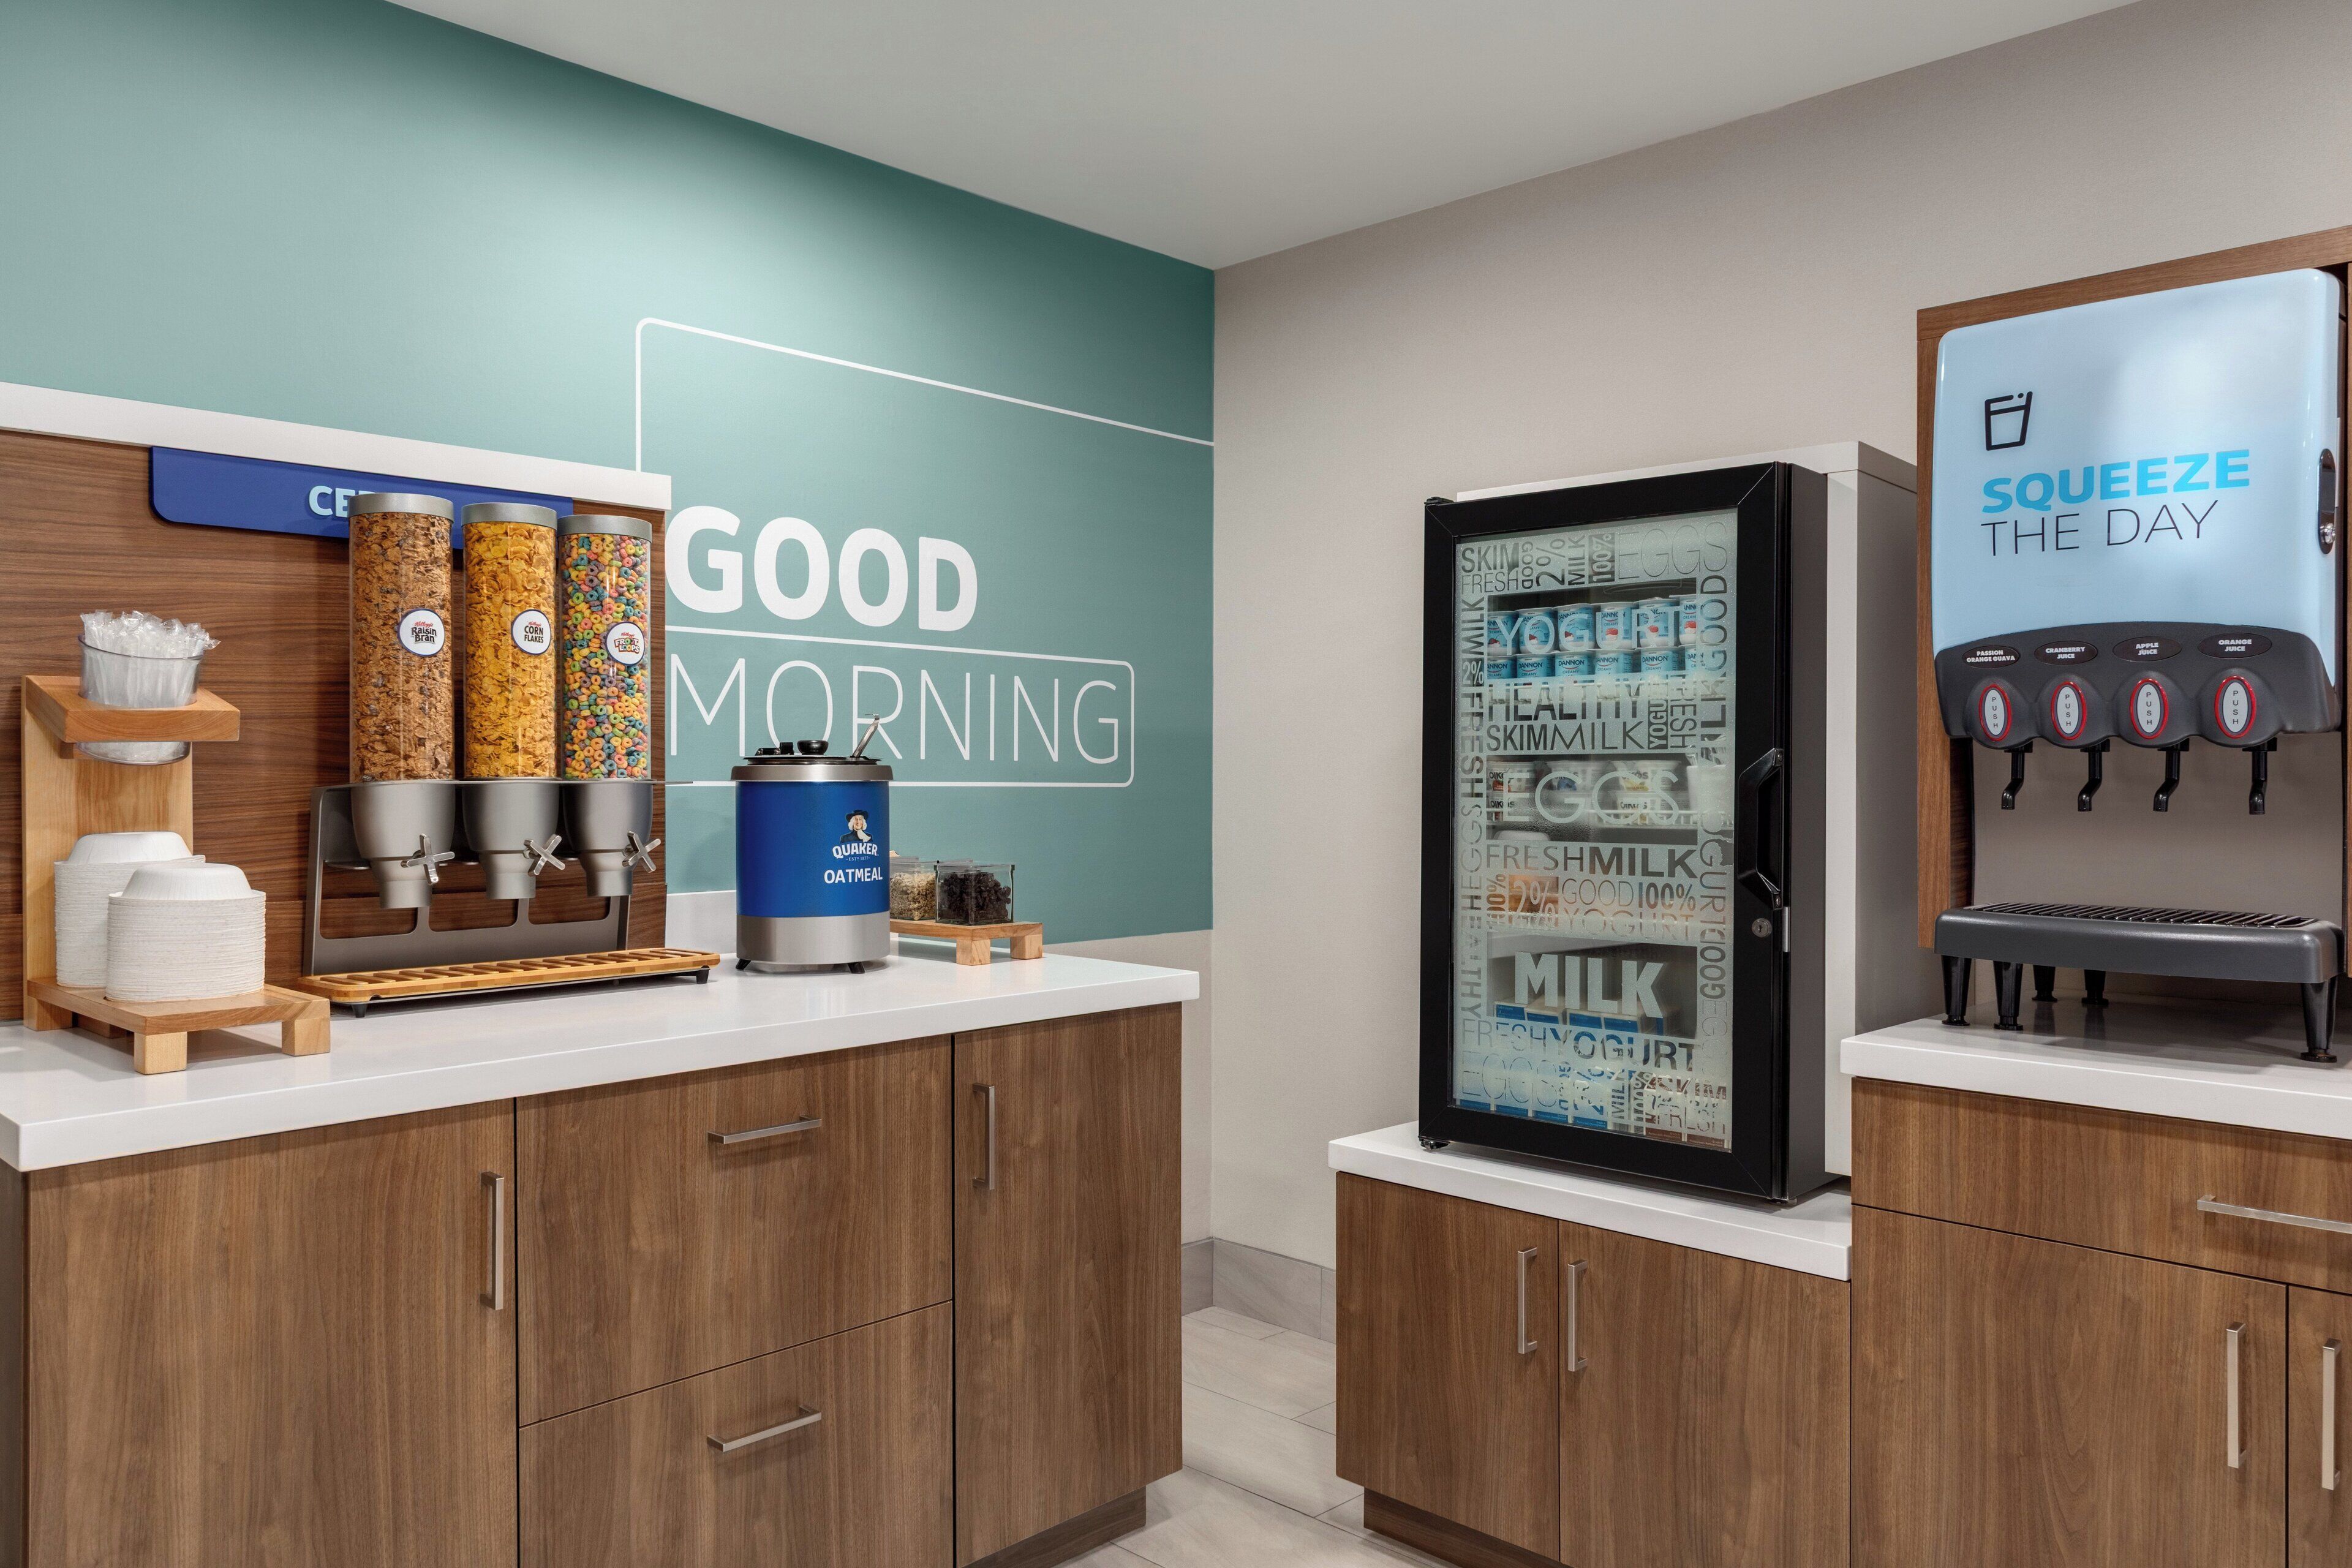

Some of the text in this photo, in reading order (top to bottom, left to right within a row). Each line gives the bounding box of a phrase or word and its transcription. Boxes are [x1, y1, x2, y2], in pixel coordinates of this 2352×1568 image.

[1982, 449, 2249, 512] SQUEEZE
[1619, 522, 1727, 579] EGGS
[1981, 500, 2218, 556] THE DAY
[665, 506, 978, 631] GOOD
[1461, 543, 1519, 573] SKIM
[1521, 541, 1534, 589] GOOD
[1536, 538, 1566, 587] 2%
[1567, 535, 1585, 586] MILK
[1593, 533, 1612, 582] 100%
[1461, 570, 1518, 594] FRESH
[411, 627, 437, 636] Raisin
[415, 635, 435, 643] Bran
[524, 625, 543, 636] CORN
[524, 634, 544, 643] FLAKES
[1461, 596, 1484, 655] MILK
[1495, 605, 1682, 656] YOGURT
[1700, 575, 1727, 671] GOOD
[1463, 660, 1483, 685] 2%
[670, 654, 1118, 764] MORNING
[1488, 677, 1645, 722] HEALTHY
[1487, 720, 1645, 751] SKIM MILK
[1503, 770, 1679, 824] EGGS
[832, 843, 878, 859] QUAKER
[1487, 844, 1697, 878] FRESH MILK
[824, 867, 883, 884] OATMEAL
[1562, 878, 1697, 911] GOOD 100%
[1515, 951, 1666, 1019] MILK
